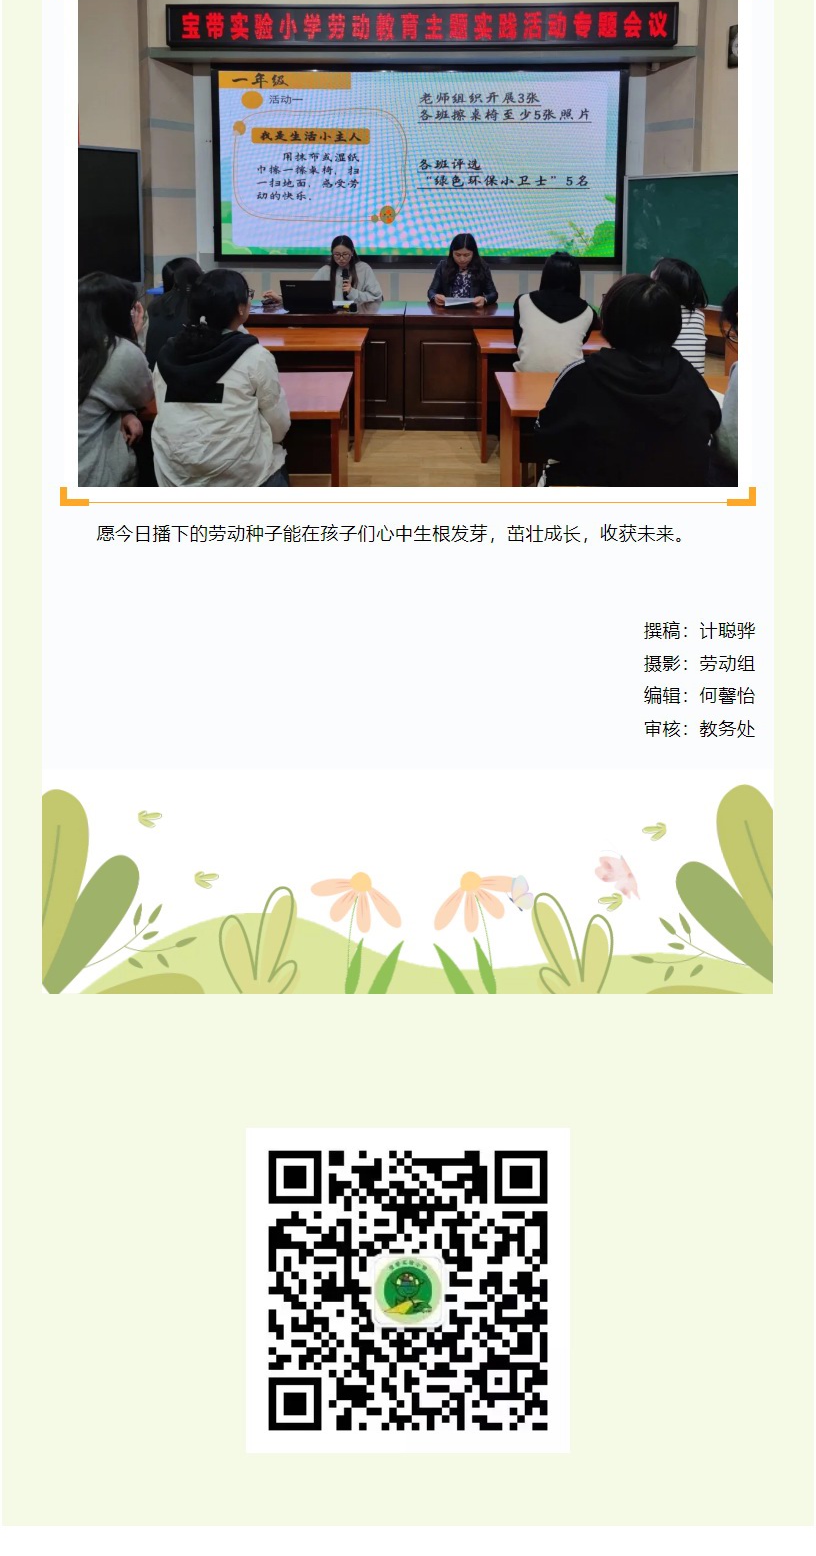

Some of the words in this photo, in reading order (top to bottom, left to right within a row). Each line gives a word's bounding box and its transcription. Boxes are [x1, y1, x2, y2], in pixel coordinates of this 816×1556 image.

[181, 10, 668, 41] 宝带实验小学劳动教育主题实践活动专题会议
[232, 73, 289, 88] 一年级
[269, 95, 303, 105] 活动一
[419, 92, 541, 104] 老师组织开展3张
[419, 108, 590, 121] 各班擦桌椅至少5张照片
[260, 130, 362, 142] 我是生活小主人
[282, 152, 360, 163] 用抹布或湿纸
[418, 158, 482, 171] 各班评选
[96, 523, 684, 544] 愿今日播下的劳动种子能在孩子们心中生根发芽，茁壮成长，收获未来。
[643, 620, 756, 640] 撰稿：计聪骅
[643, 654, 756, 673] 摄影：劳动组
[643, 685, 756, 705] 编辑：何馨怡
[643, 719, 756, 739] 审核：教务处
